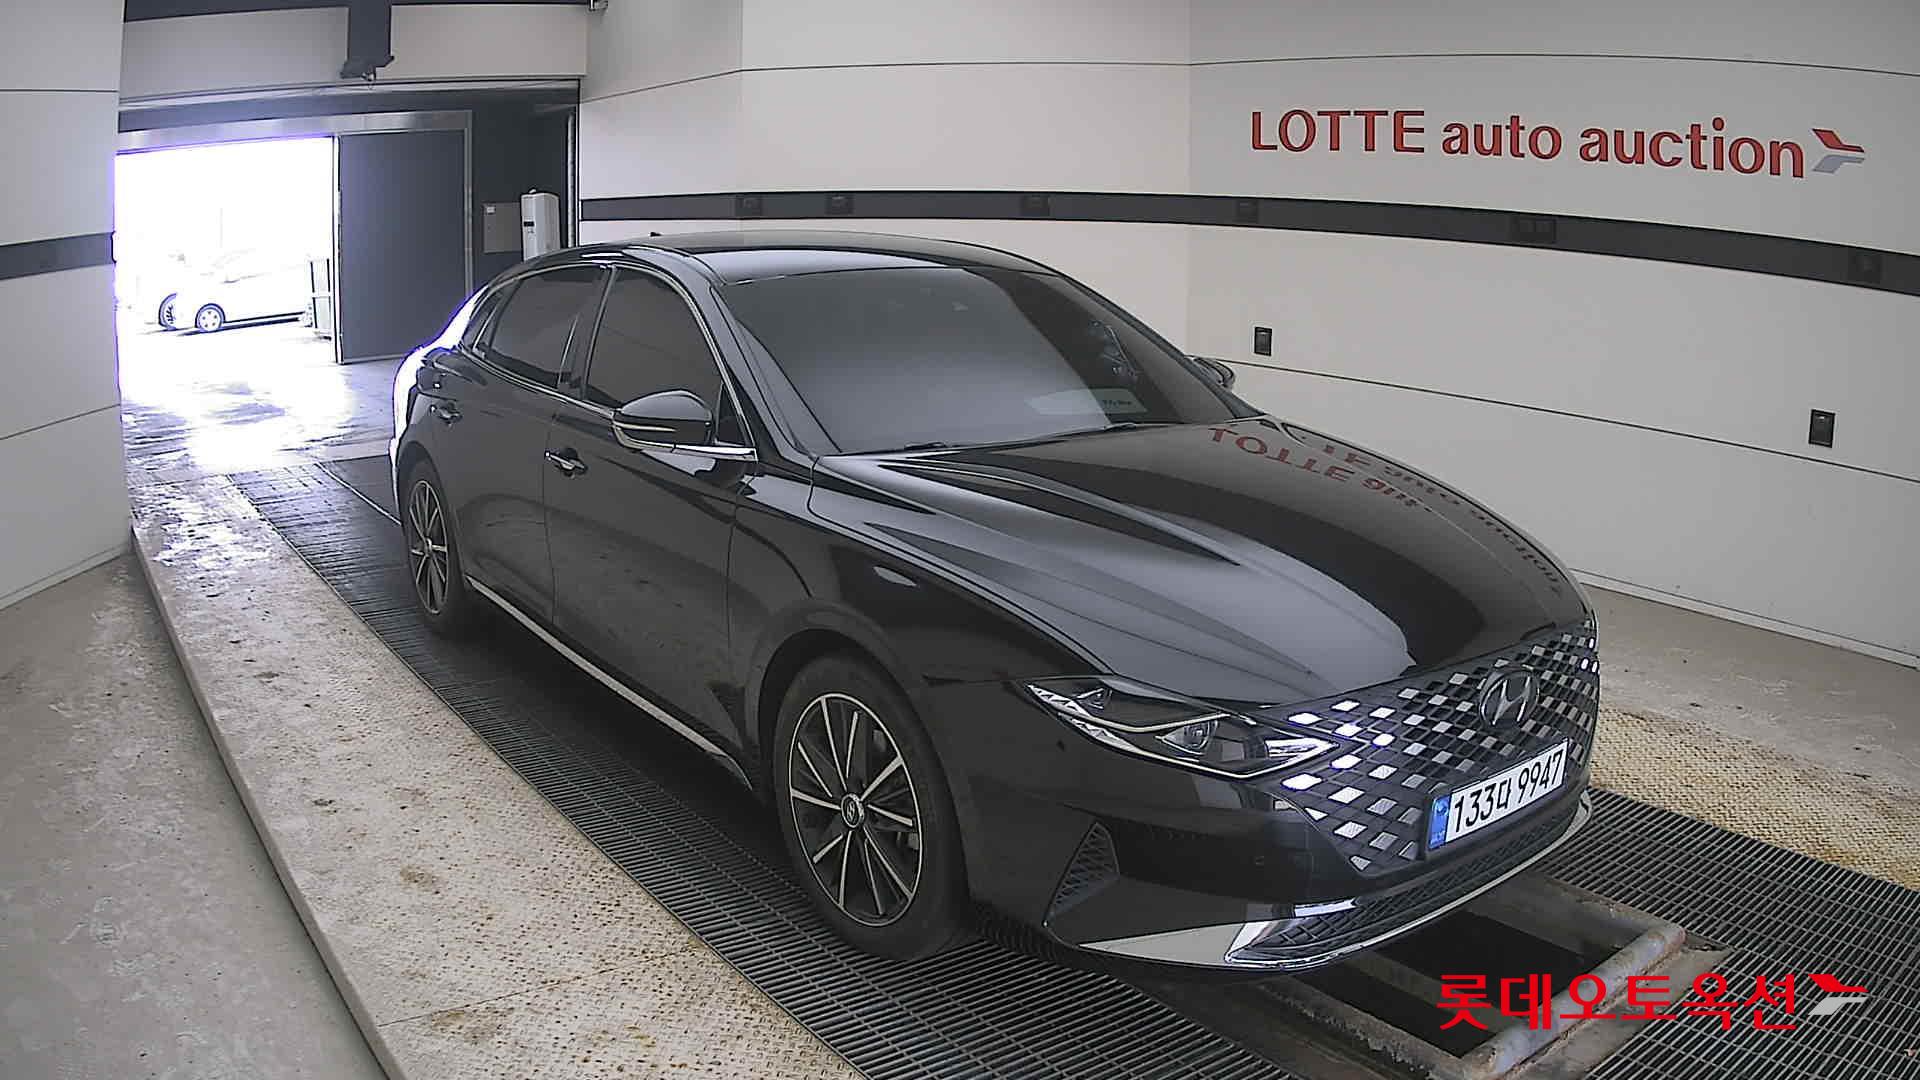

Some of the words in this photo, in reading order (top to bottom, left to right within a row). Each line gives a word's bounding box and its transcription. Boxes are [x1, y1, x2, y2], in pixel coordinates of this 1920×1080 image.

[1251, 110, 1425, 153] LOTTE
[1442, 116, 1562, 161] auto
[1581, 117, 1806, 178] auction
[1518, 749, 1564, 804] 9947
